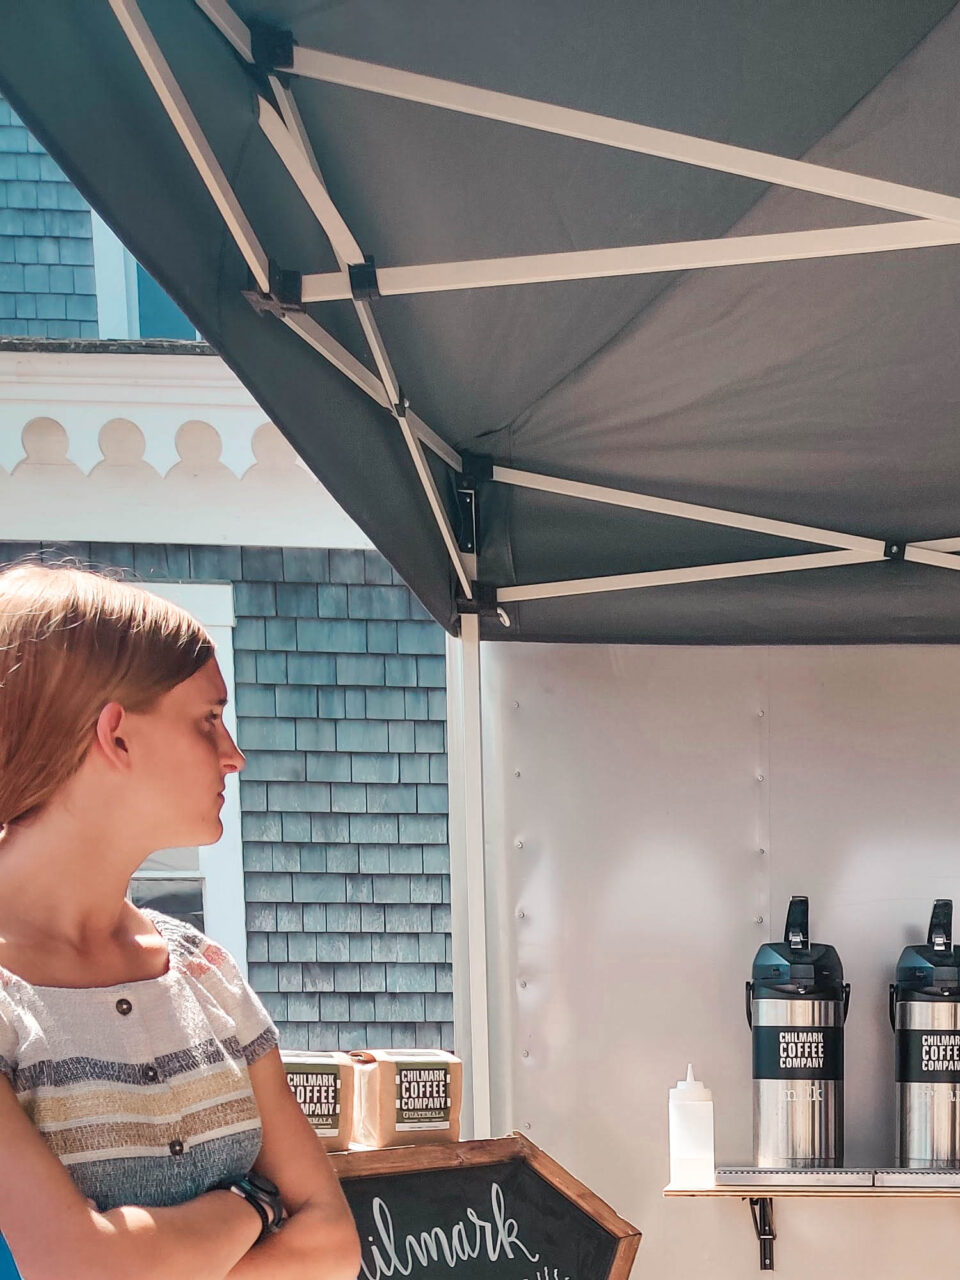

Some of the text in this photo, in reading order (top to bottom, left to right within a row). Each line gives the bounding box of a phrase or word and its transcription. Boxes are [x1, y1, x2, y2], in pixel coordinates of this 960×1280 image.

[779, 1032, 823, 1043] CHILMARK
[780, 1042, 824, 1058] COFFEE
[780, 1057, 824, 1069] COMPANY
[286, 1073, 335, 1086] CHILMARK
[401, 1070, 445, 1082] CHILMARK
[289, 1086, 335, 1103] OFFEE
[401, 1081, 446, 1098] COFFEE
[300, 1103, 334, 1115] MPANY
[401, 1097, 446, 1110] COMPANY
